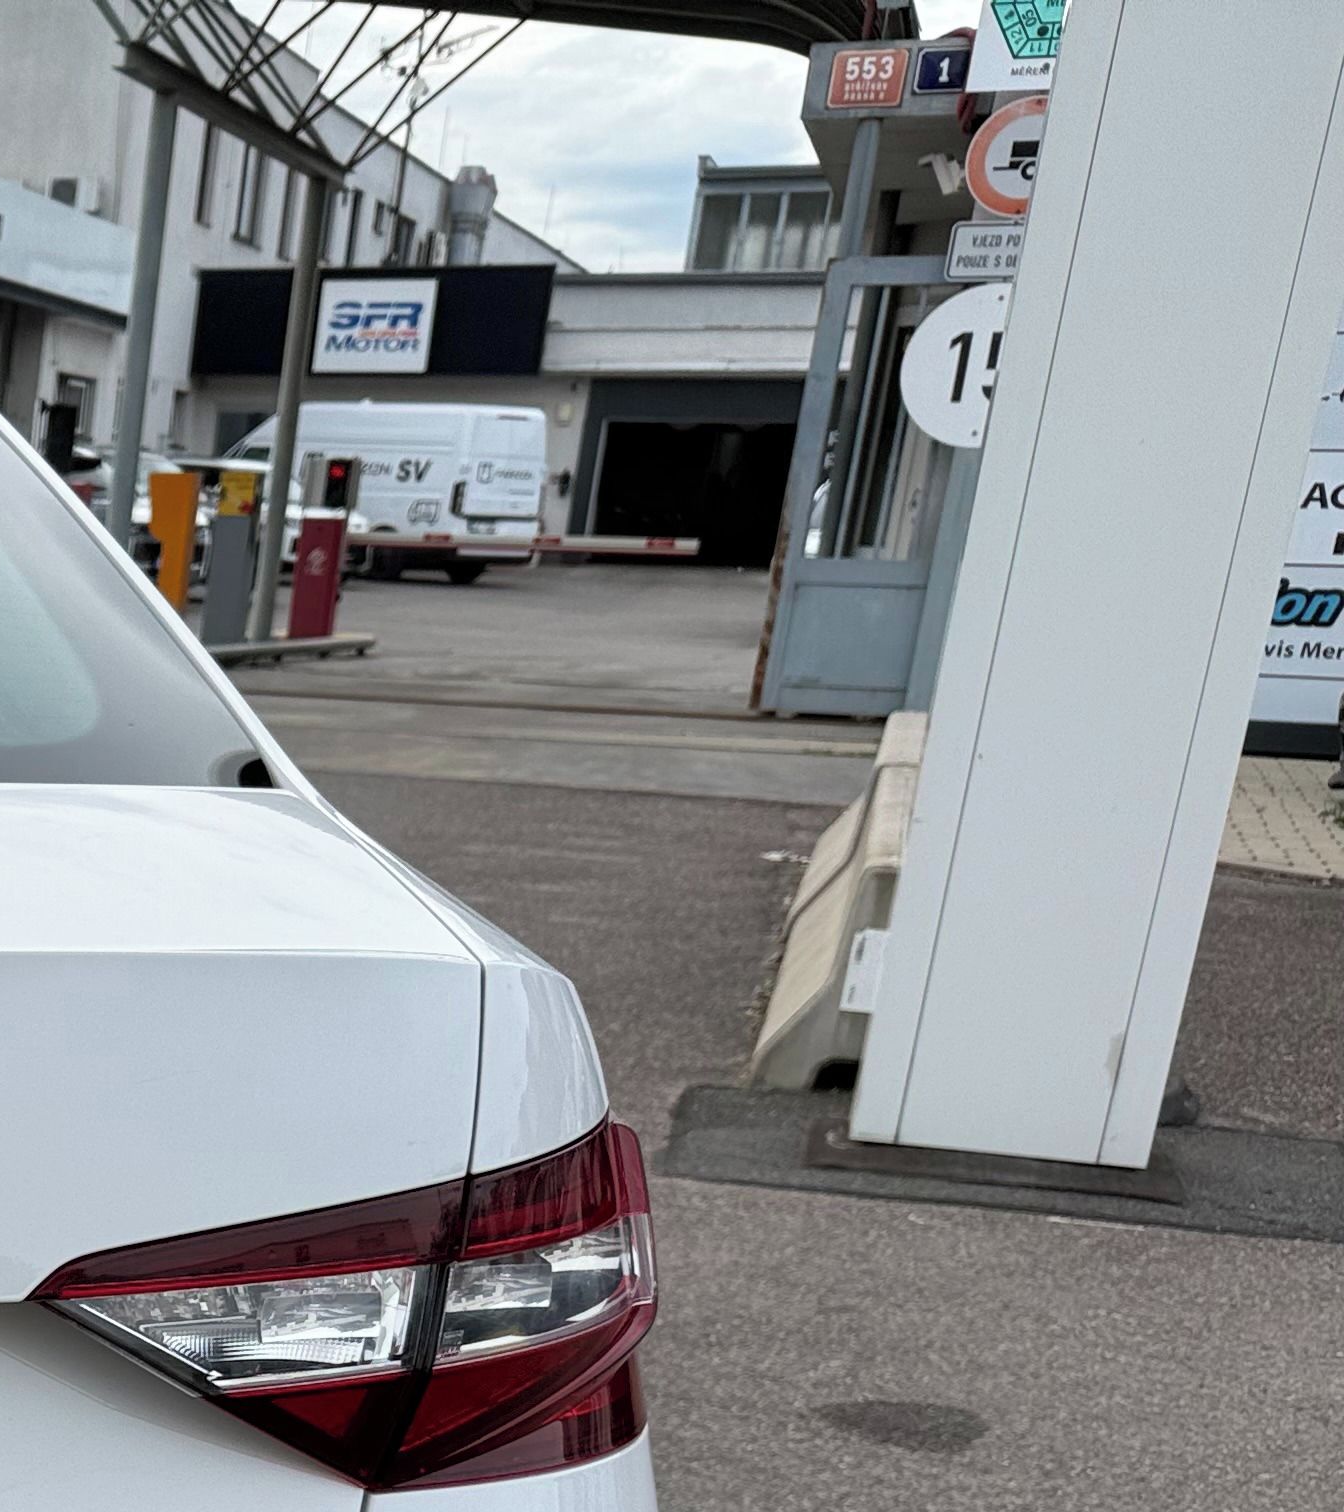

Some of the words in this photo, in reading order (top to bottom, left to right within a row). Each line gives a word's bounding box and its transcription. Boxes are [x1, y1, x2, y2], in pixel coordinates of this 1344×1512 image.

[845, 55, 895, 81] 553
[938, 56, 950, 83] 1
[328, 302, 423, 329] SFR
[396, 458, 432, 482] SV
[1272, 590, 1343, 625] on
